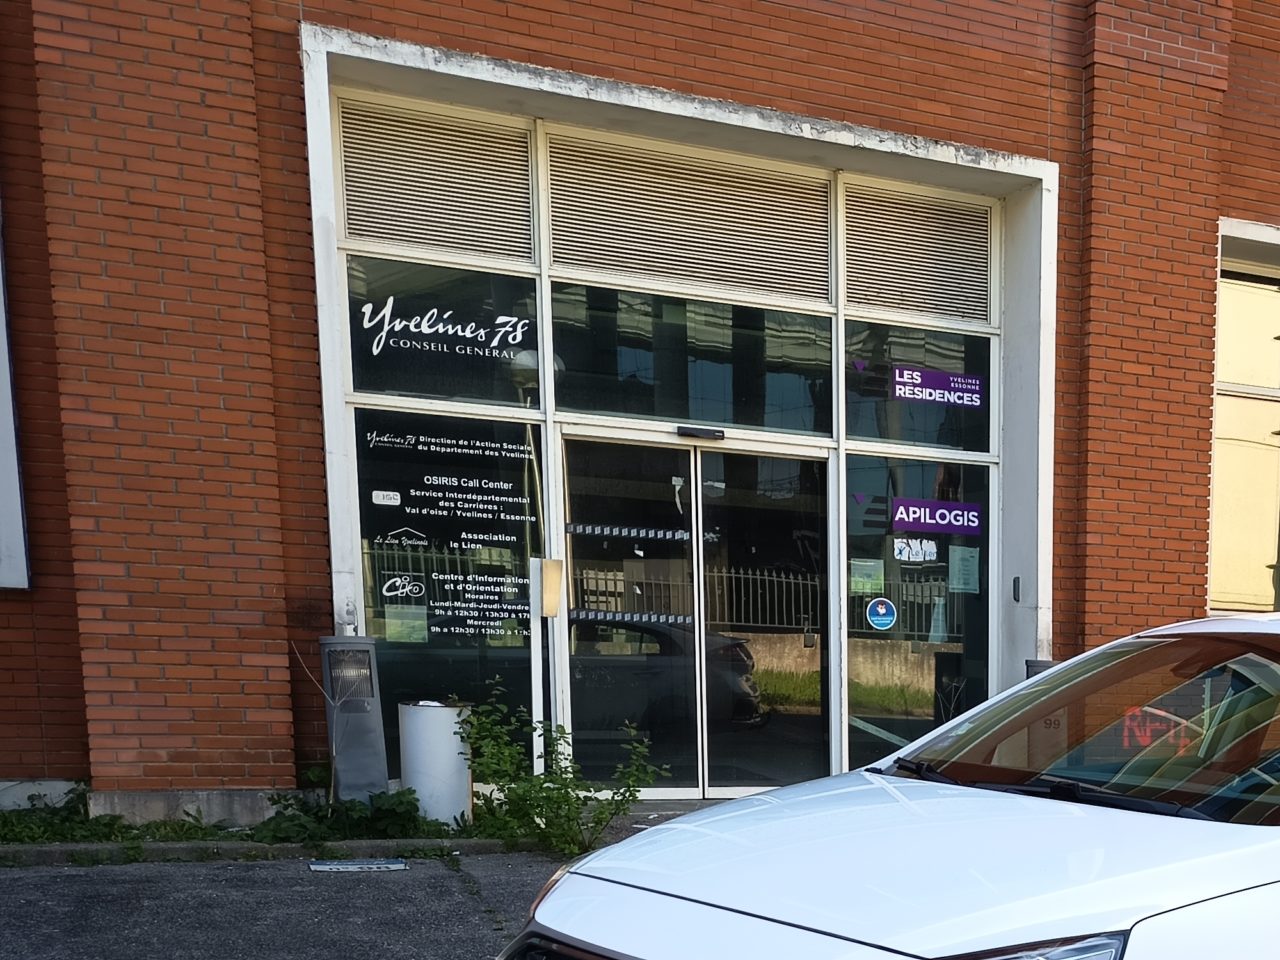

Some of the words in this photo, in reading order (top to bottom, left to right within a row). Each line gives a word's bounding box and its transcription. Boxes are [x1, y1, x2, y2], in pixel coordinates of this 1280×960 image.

[361, 296, 491, 356] Yvelines
[490, 315, 530, 348] 78
[389, 339, 450, 353] CONSEIL
[456, 345, 516, 359] GENERAL
[895, 369, 922, 384] LES
[949, 376, 980, 384] YVELINES
[950, 383, 980, 391] ESSONNE
[895, 384, 981, 406] RÉSIDENCES
[405, 435, 418, 445] 78
[419, 435, 456, 445] Direction
[470, 440, 500, 448] l'Action
[502, 442, 531, 451] Sociale
[430, 444, 482, 455] Département
[484, 449, 499, 457] des
[501, 450, 534, 459] Yvelines
[423, 475, 458, 486] OSIRIS
[460, 478, 479, 488] Call
[481, 479, 513, 490] Center
[409, 489, 443, 498] Service
[445, 491, 530, 504] Interdépartemental
[457, 501, 498, 510] Carrières
[405, 506, 419, 514] Val
[421, 507, 448, 516] d'oise
[456, 510, 493, 519] Yvelines
[500, 512, 536, 522] Essonne
[894, 505, 979, 527] APILOGIS
[460, 531, 517, 542] Association
[450, 540, 459, 548] le
[461, 541, 483, 549] Lien
[431, 572, 464, 581] Centre
[466, 574, 530, 584] d'Information
[456, 583, 519, 593] d'Orientation
[464, 592, 499, 600] Horaires
[434, 608, 445, 616] 9h
[454, 609, 478, 617] 12h30
[484, 610, 509, 618] 13h30
[466, 618, 502, 626] Mercredi
[450, 626, 475, 634] 12h30
[480, 627, 505, 635] 13h30
